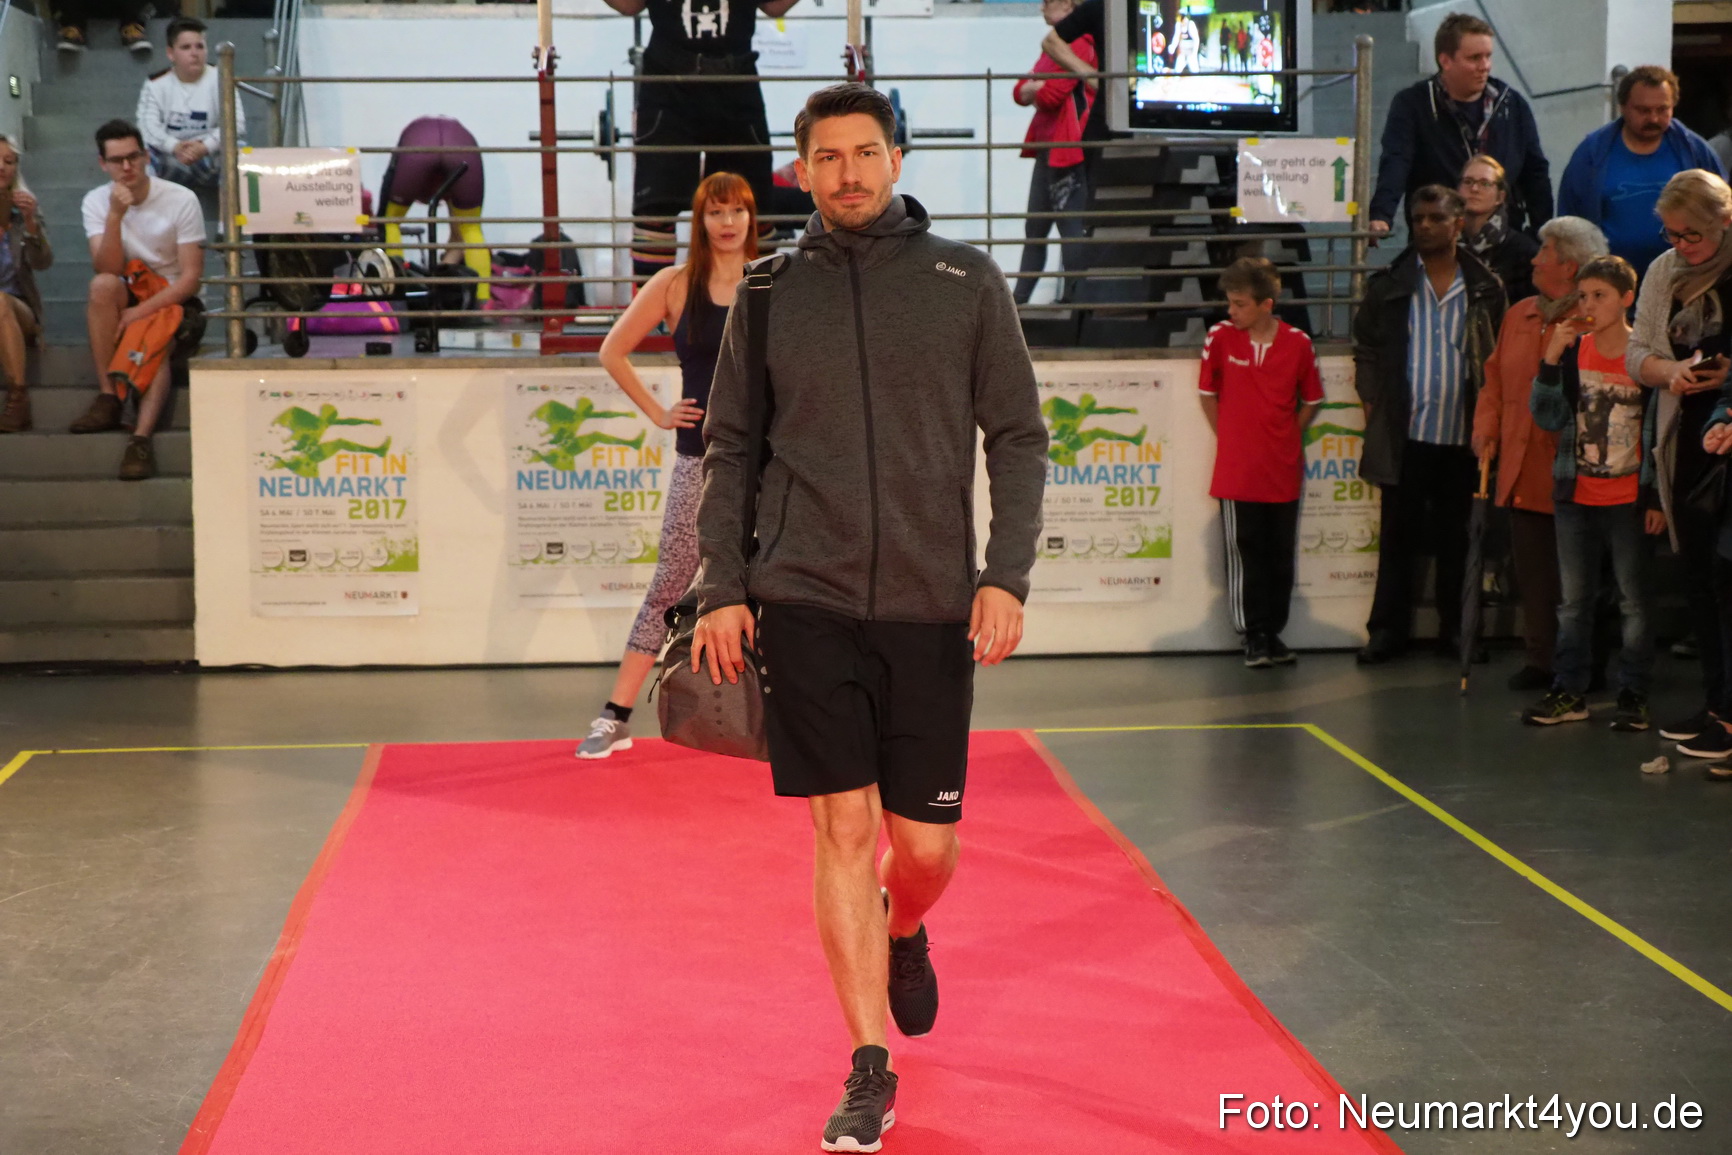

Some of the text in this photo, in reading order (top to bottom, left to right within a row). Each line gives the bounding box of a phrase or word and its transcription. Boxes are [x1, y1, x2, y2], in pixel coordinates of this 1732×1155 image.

[1281, 157, 1306, 169] geht
[1309, 157, 1326, 167] die
[285, 181, 354, 193] Ausstellung
[315, 195, 354, 206] weiter!
[945, 265, 967, 277] JAKO
[591, 446, 663, 467] FIT IN
[1092, 441, 1163, 463] FIT IN
[1321, 436, 1360, 457] FIT
[335, 454, 407, 475] FIT IN
[1045, 463, 1162, 485] UMARKT
[258, 476, 407, 497] NEUMARKT
[516, 468, 662, 490] NEUMARKT
[604, 490, 662, 512] 2017
[1104, 486, 1162, 507] 2017
[1333, 481, 1376, 502] 201
[348, 498, 407, 519] 2017
[1100, 576, 1152, 586] NEUMARKT
[1329, 571, 1376, 580] NEUMARK
[344, 590, 398, 600] NEUMARKT
[601, 582, 649, 591] NEUMARK
[936, 790, 959, 801] JAKO
